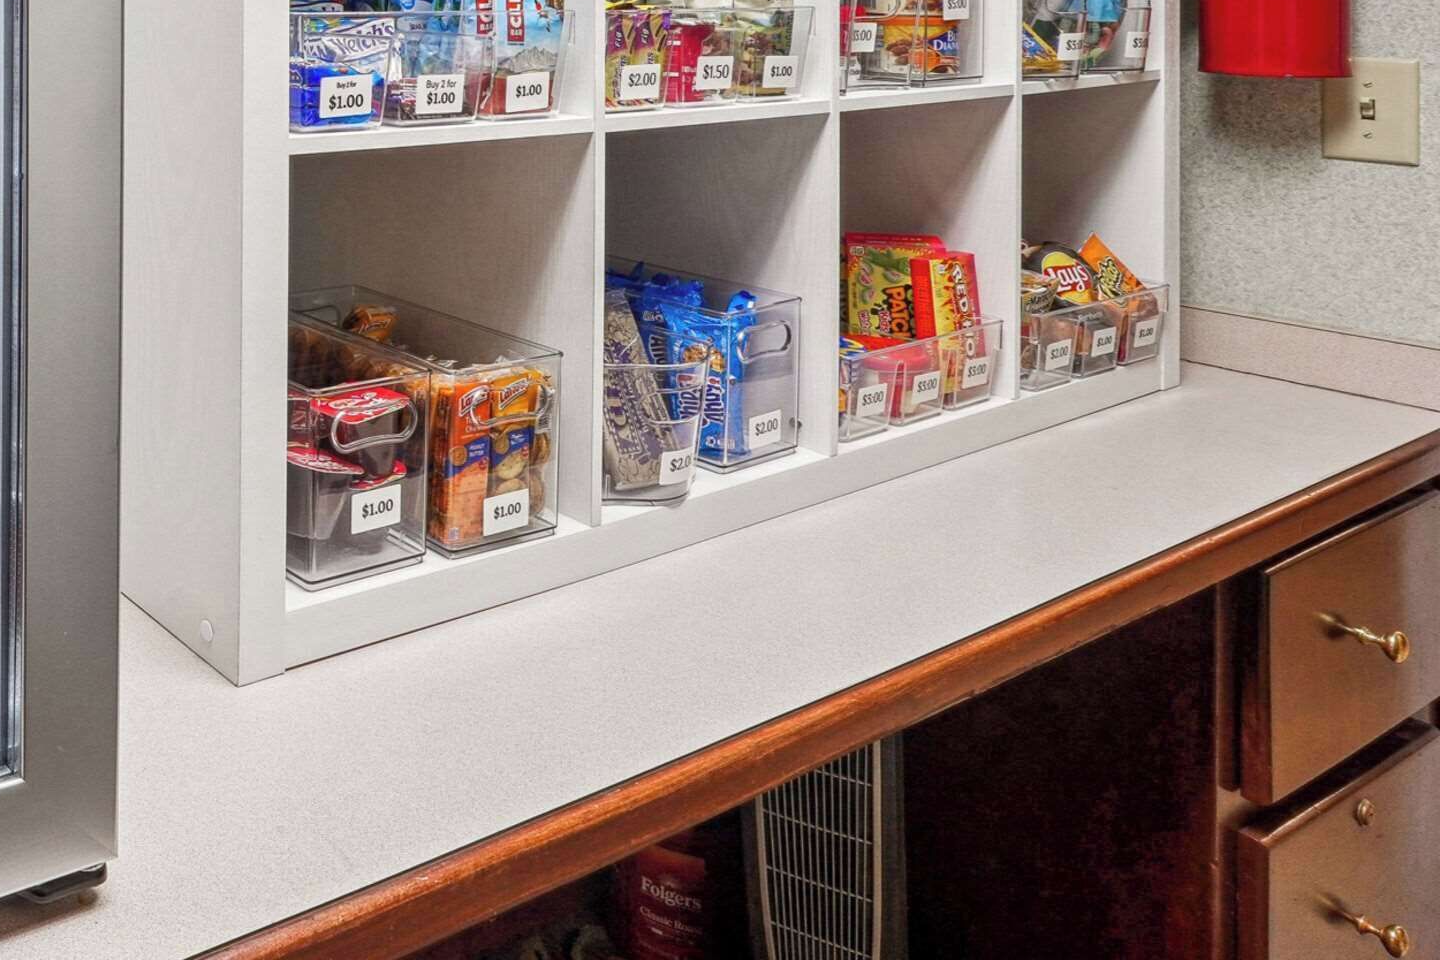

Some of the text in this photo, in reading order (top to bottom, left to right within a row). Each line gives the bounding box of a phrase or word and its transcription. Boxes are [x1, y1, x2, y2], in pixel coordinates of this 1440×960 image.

[628, 72, 657, 87] $2.00
[702, 64, 729, 80] $1.50
[771, 66, 793, 78] $1.00
[425, 79, 457, 90] Buy 2 for
[515, 84, 542, 98] $1.00
[329, 94, 364, 110] $1.00
[426, 91, 455, 105] $1.00
[755, 418, 778, 436] $2.00
[670, 458, 691, 472] $2.0
[362, 499, 394, 518] $1.00
[493, 502, 521, 520] $1.00
[641, 876, 701, 909] Folgers
